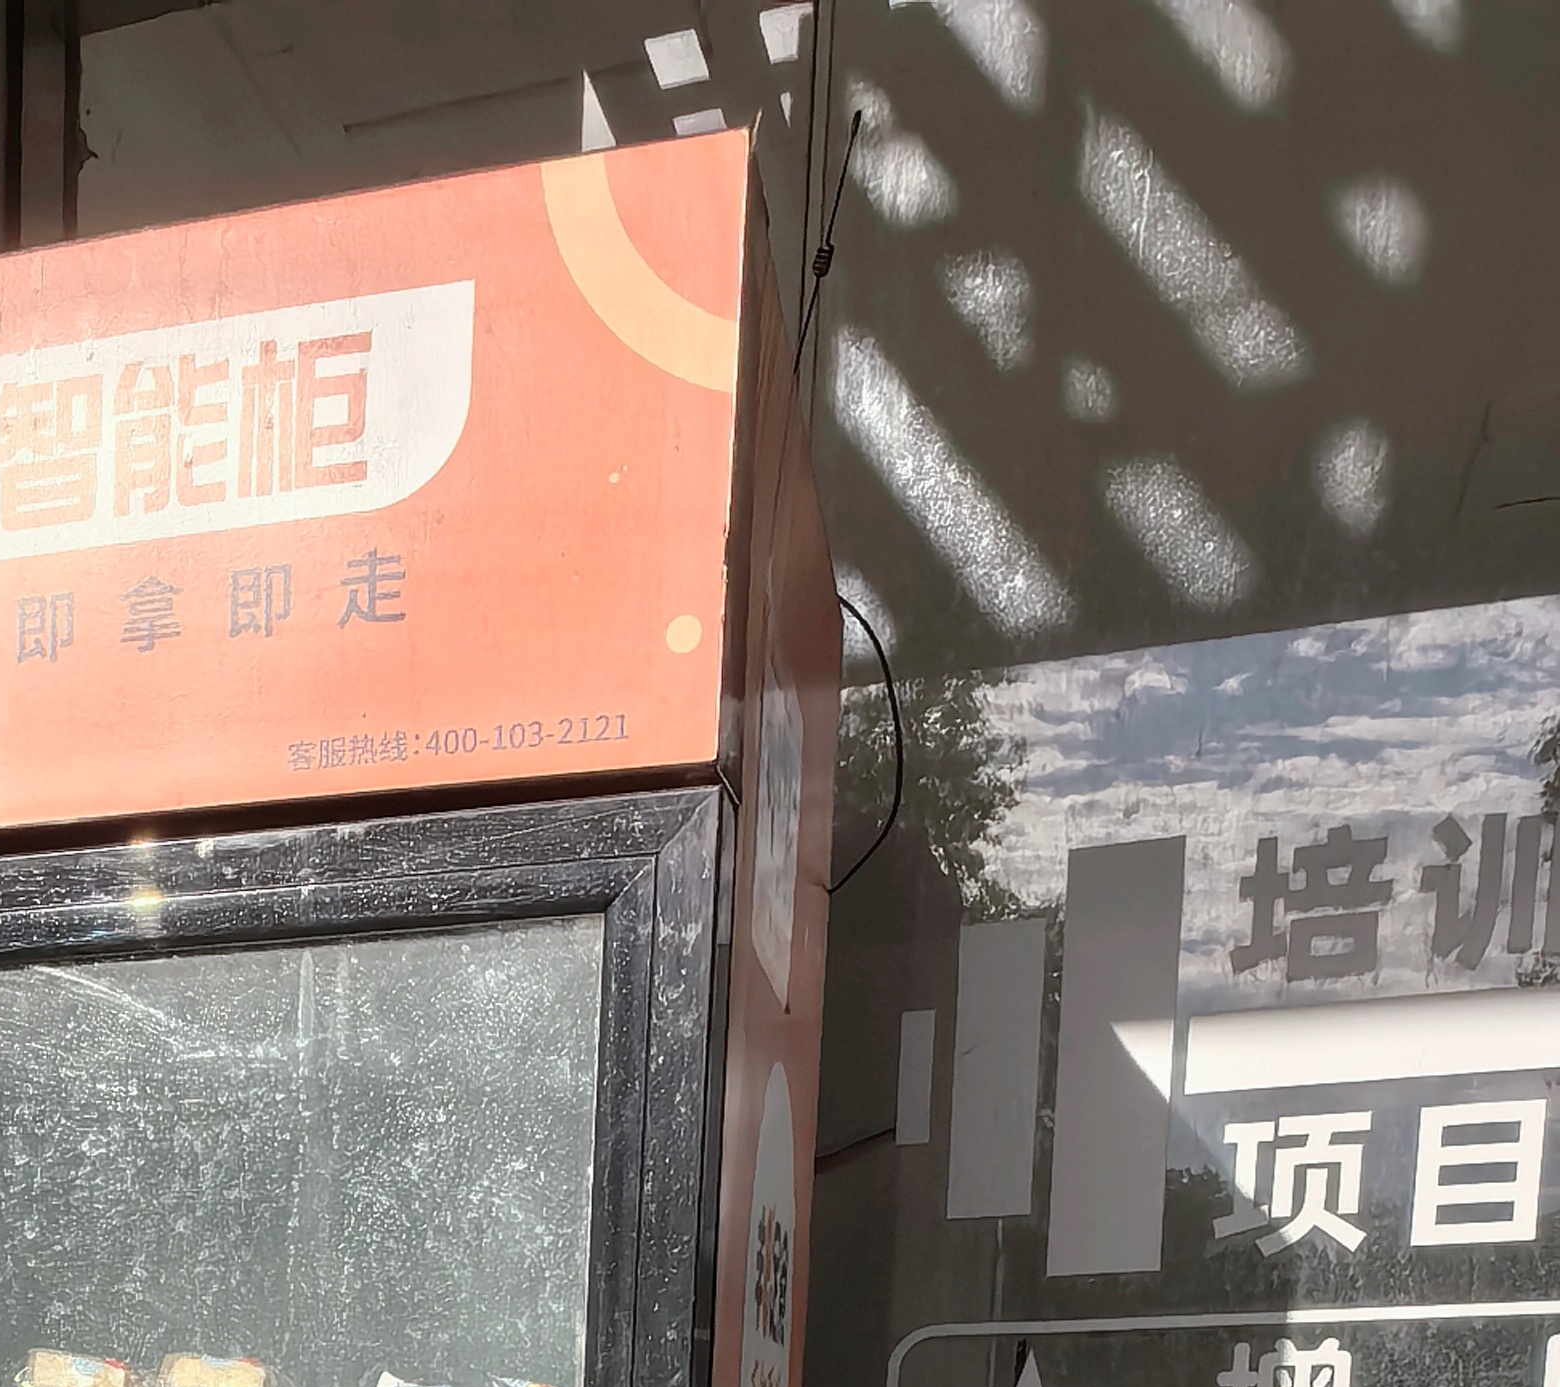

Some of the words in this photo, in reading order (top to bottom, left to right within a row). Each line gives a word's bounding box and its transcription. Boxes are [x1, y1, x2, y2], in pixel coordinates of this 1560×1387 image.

[16, 547, 407, 664] 即拿即走
[1230, 813, 1560, 981] 培训
[1213, 1098, 1547, 1257] 项目
